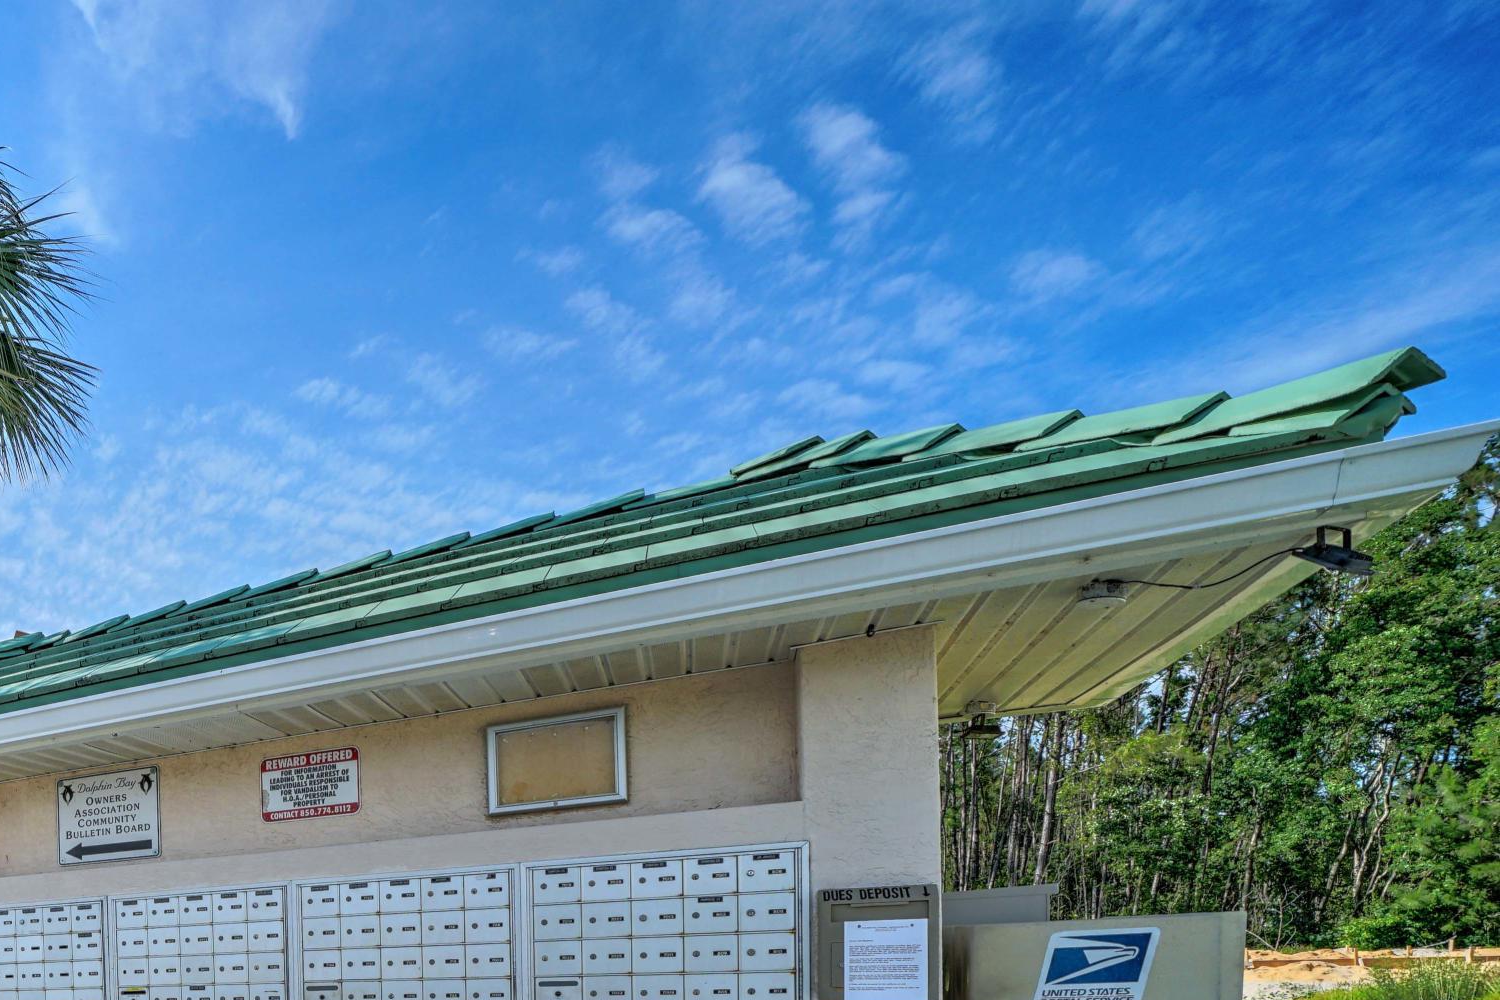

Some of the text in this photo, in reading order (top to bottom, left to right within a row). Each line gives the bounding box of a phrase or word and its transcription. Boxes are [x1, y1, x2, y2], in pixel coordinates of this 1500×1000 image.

[265, 749, 353, 770] REWARD OFFERED
[294, 764, 337, 775] INFORMATION
[270, 776, 294, 784] LEADING
[316, 770, 339, 779] ARREST
[270, 775, 350, 791] INDIVIDUALS RESPONSIBLE
[77, 777, 137, 794] Dolphin Bay
[294, 784, 328, 794] VANDALISM
[86, 794, 128, 806] OWNERS
[293, 798, 326, 808] PROPERTY
[74, 802, 140, 818] ASSOCIATION
[270, 810, 299, 820] CONTACT
[78, 814, 137, 828] COMMUNITY
[66, 824, 151, 840] BULLETIN BOARD
[822, 886, 911, 901] DUES DEPOSIT
[1042, 987, 1131, 997] UNITED STATES
